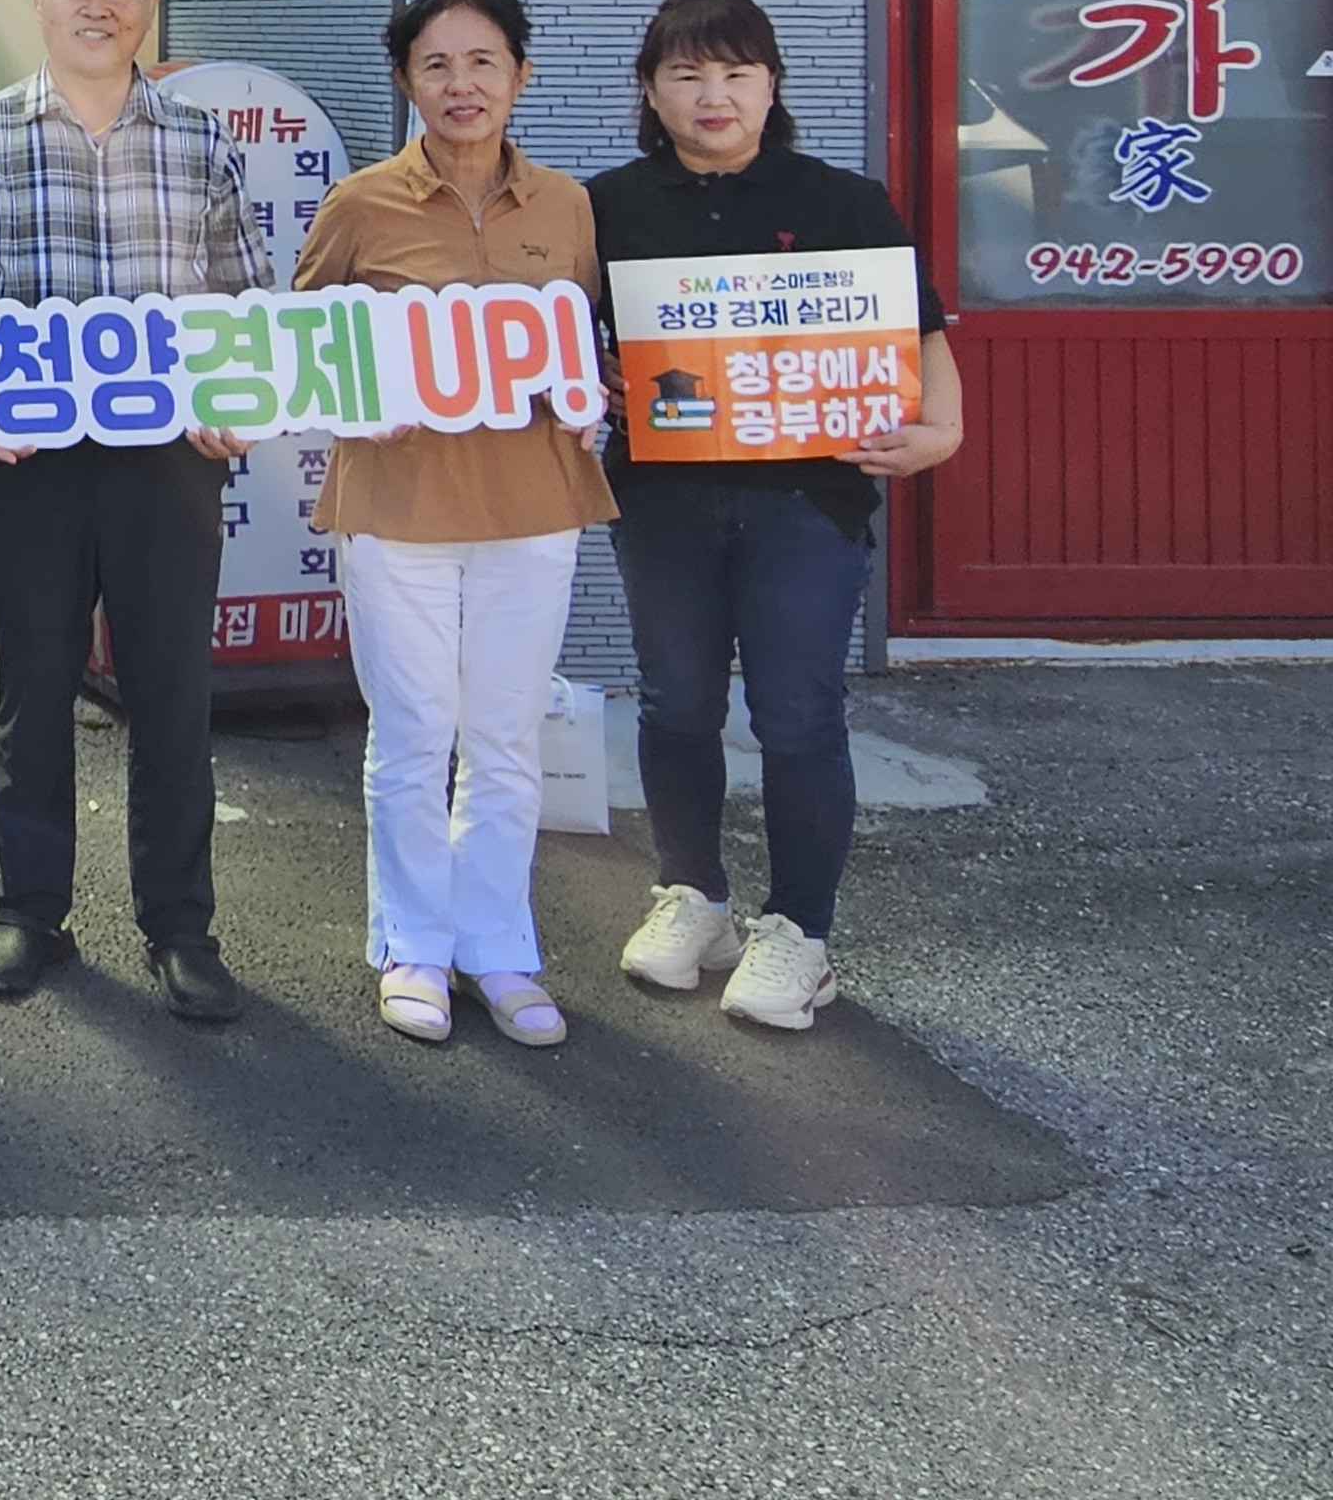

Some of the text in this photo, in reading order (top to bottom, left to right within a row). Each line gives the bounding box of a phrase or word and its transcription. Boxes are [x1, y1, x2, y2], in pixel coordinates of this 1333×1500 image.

[212, 107, 307, 143] 메뉴
[1027, 242, 1303, 286] 942-5990
[657, 294, 879, 330] 청양 경제 살리기
[409, 297, 584, 420] UP!
[725, 345, 899, 396] 청양에서
[731, 393, 903, 445] 공부하자
